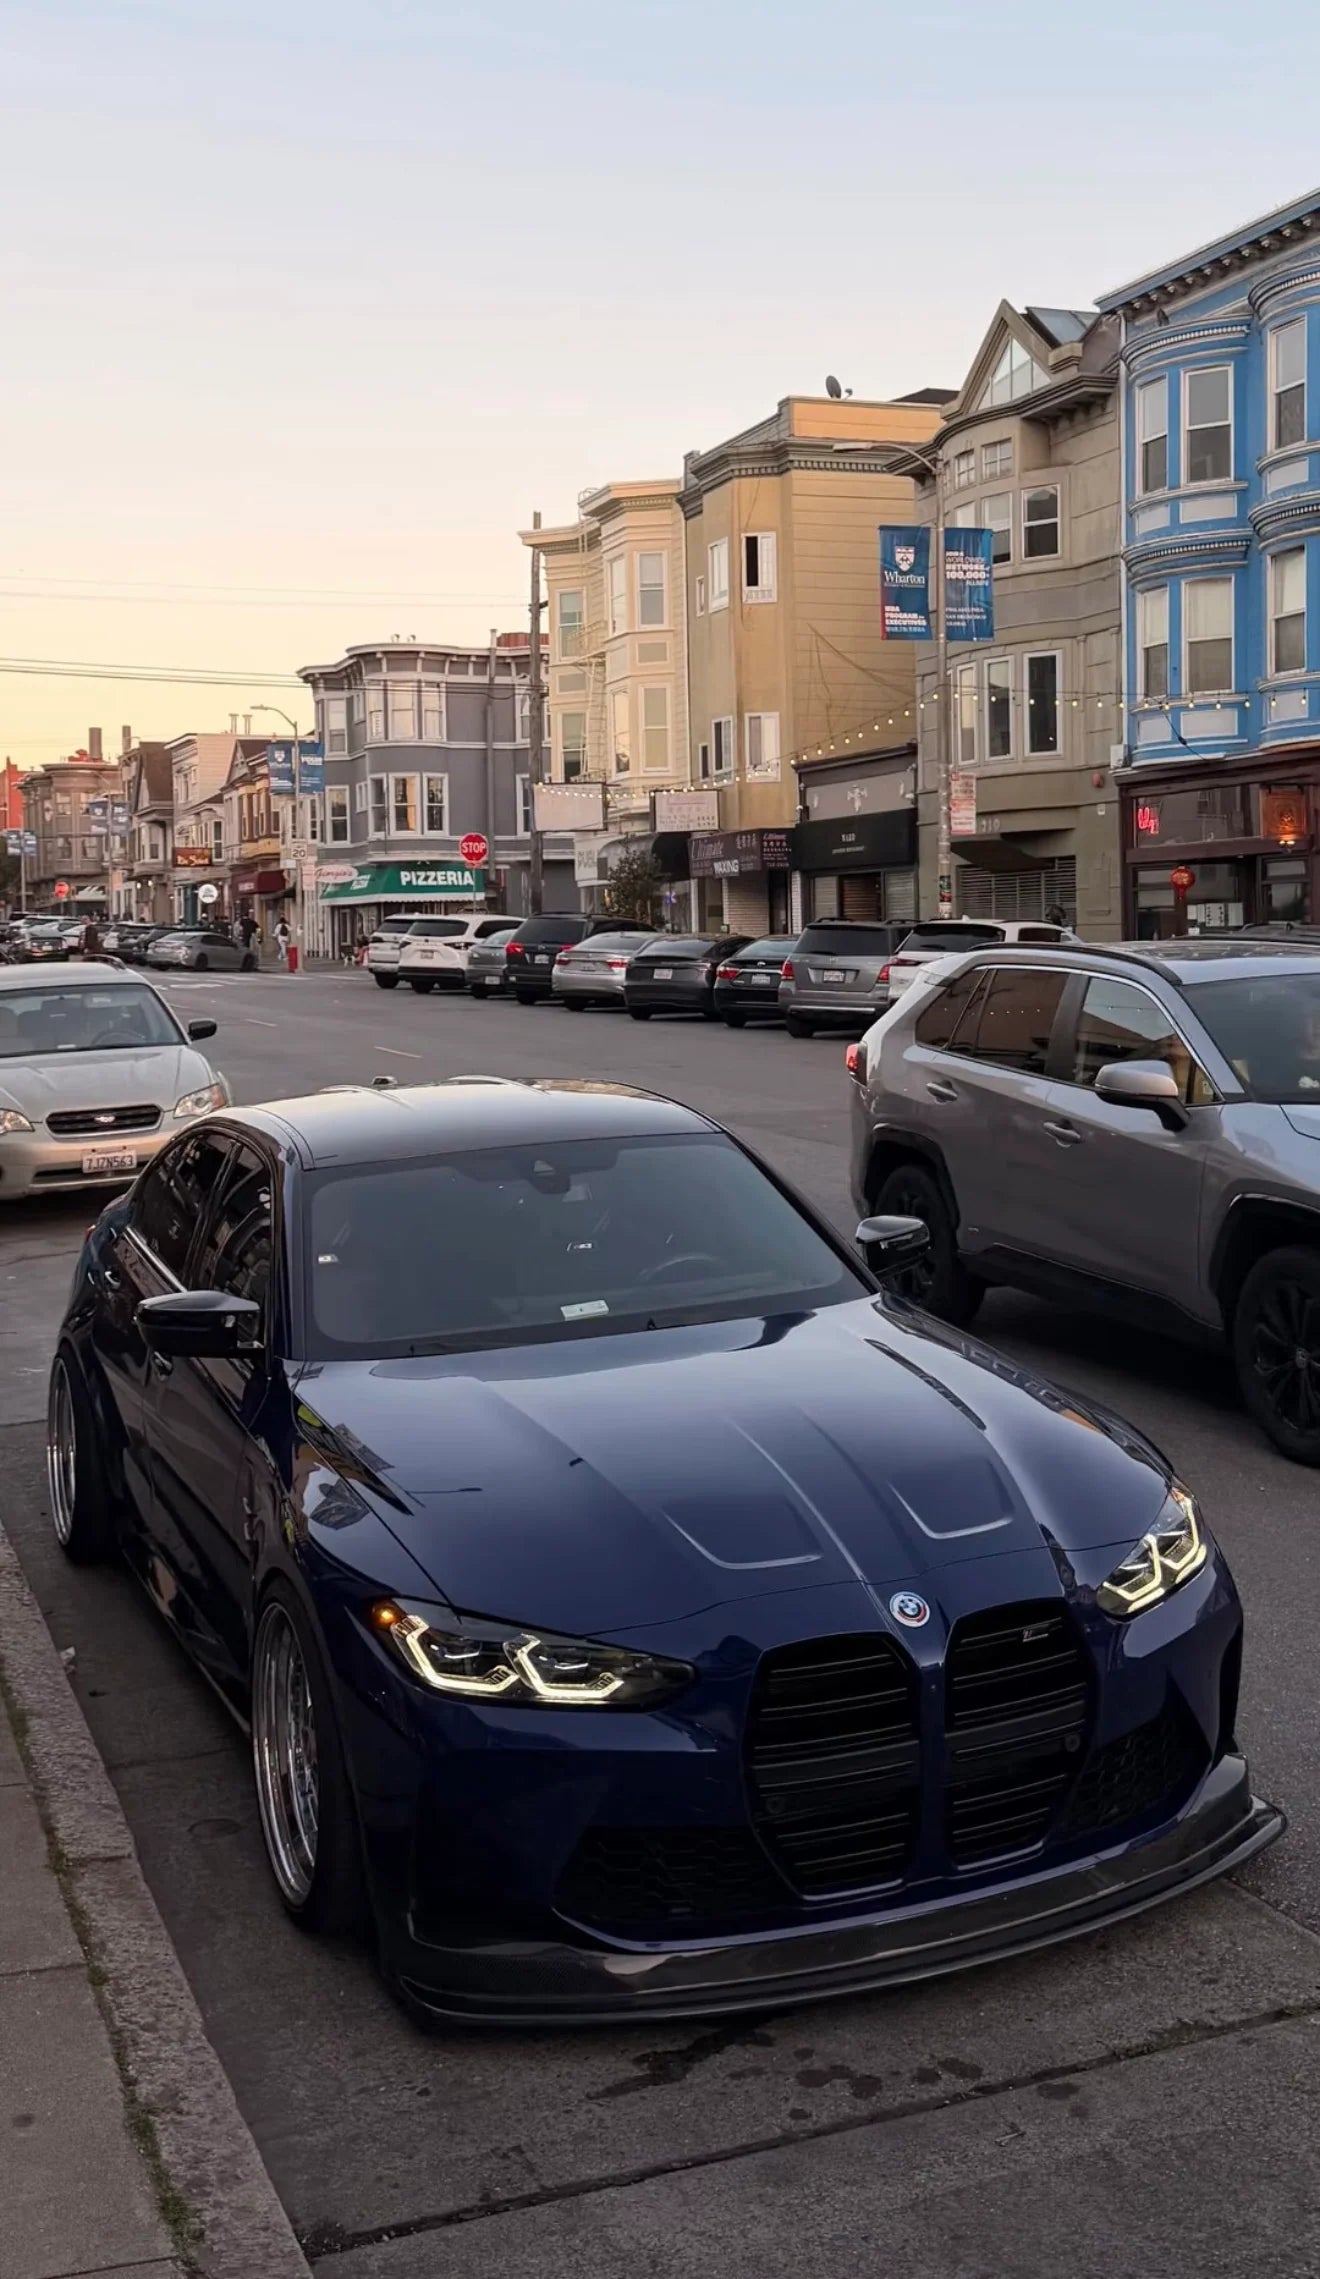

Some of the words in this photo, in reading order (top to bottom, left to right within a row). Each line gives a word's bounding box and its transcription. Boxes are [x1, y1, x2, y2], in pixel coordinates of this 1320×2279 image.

[945, 563, 985, 571] NETWORK
[884, 571, 925, 584] Wharton
[292, 849, 306, 858] 20
[462, 842, 486, 853] STOP
[714, 860, 740, 874] WAXING
[401, 870, 474, 886] PIZZERIA
